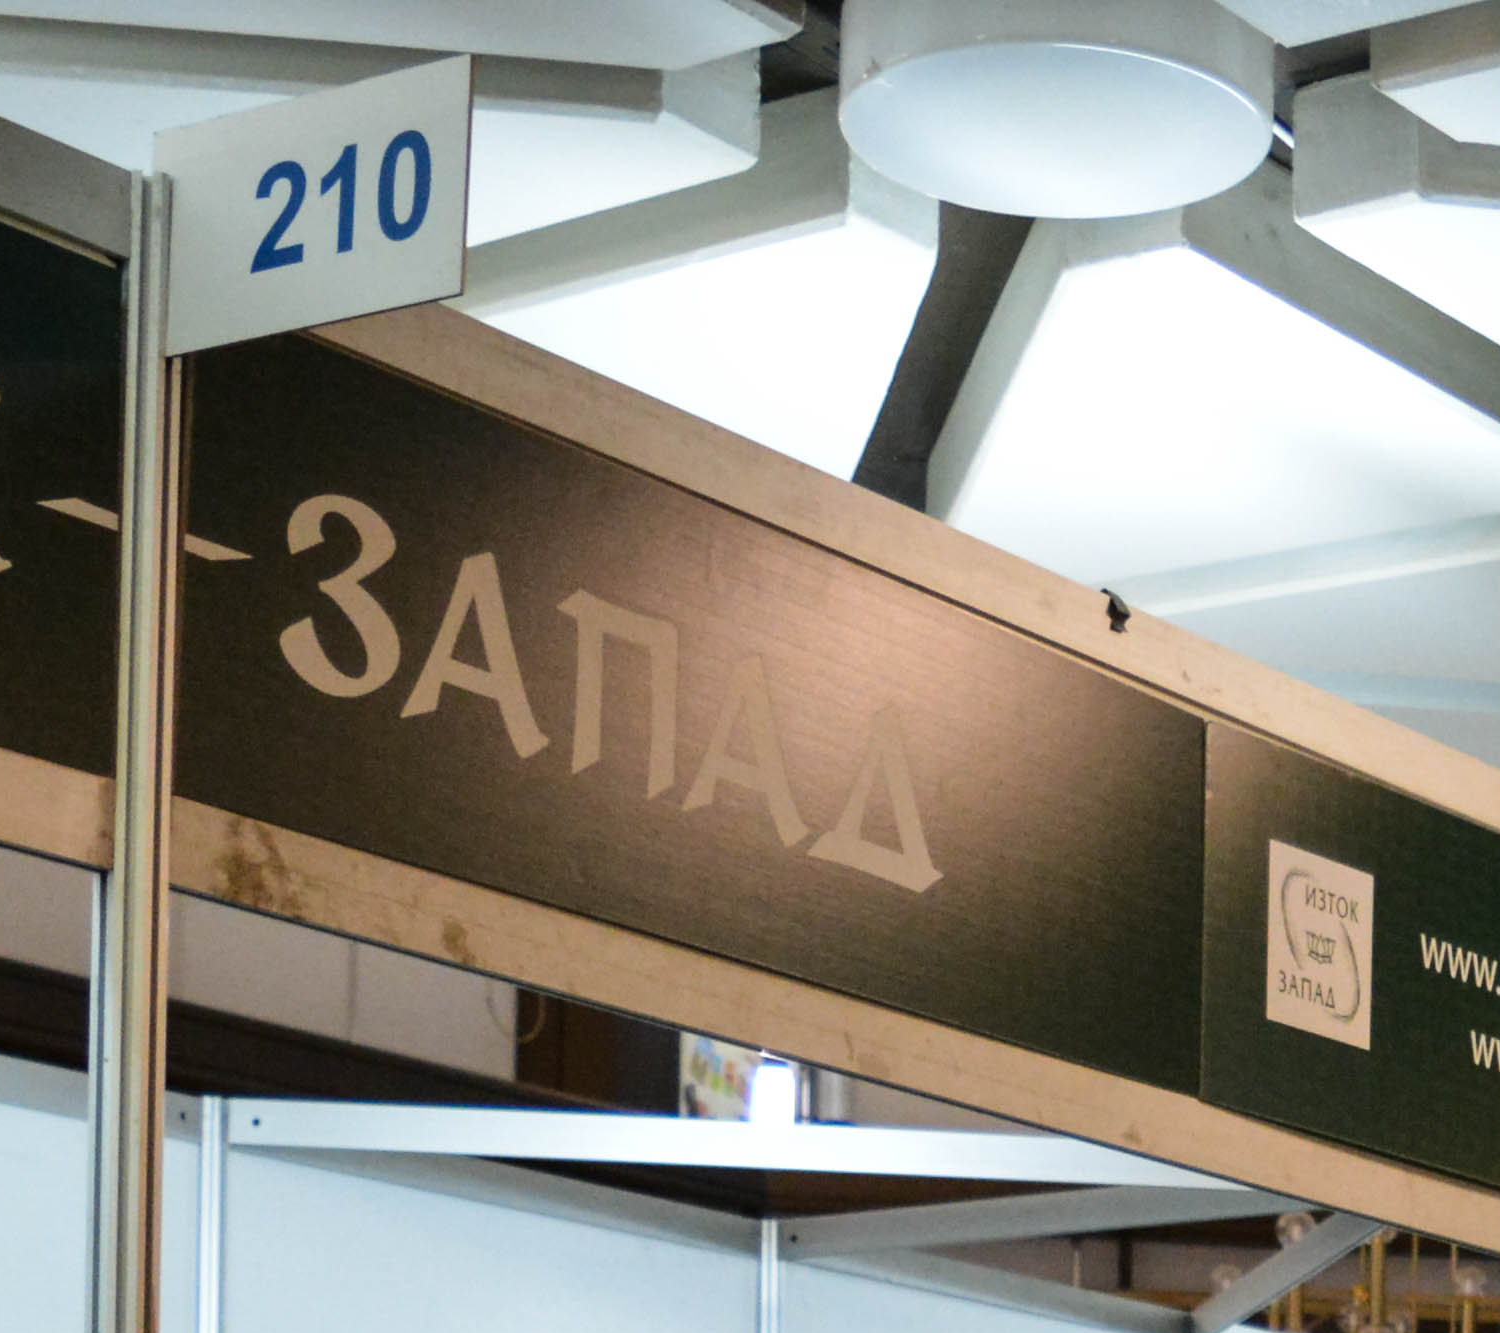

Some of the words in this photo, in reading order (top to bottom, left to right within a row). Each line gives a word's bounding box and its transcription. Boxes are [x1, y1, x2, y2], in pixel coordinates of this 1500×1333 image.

[248, 128, 432, 277] 210
[1303, 882, 1360, 926] ИЗТОК
[1277, 968, 1337, 1011] ЗАПАД
